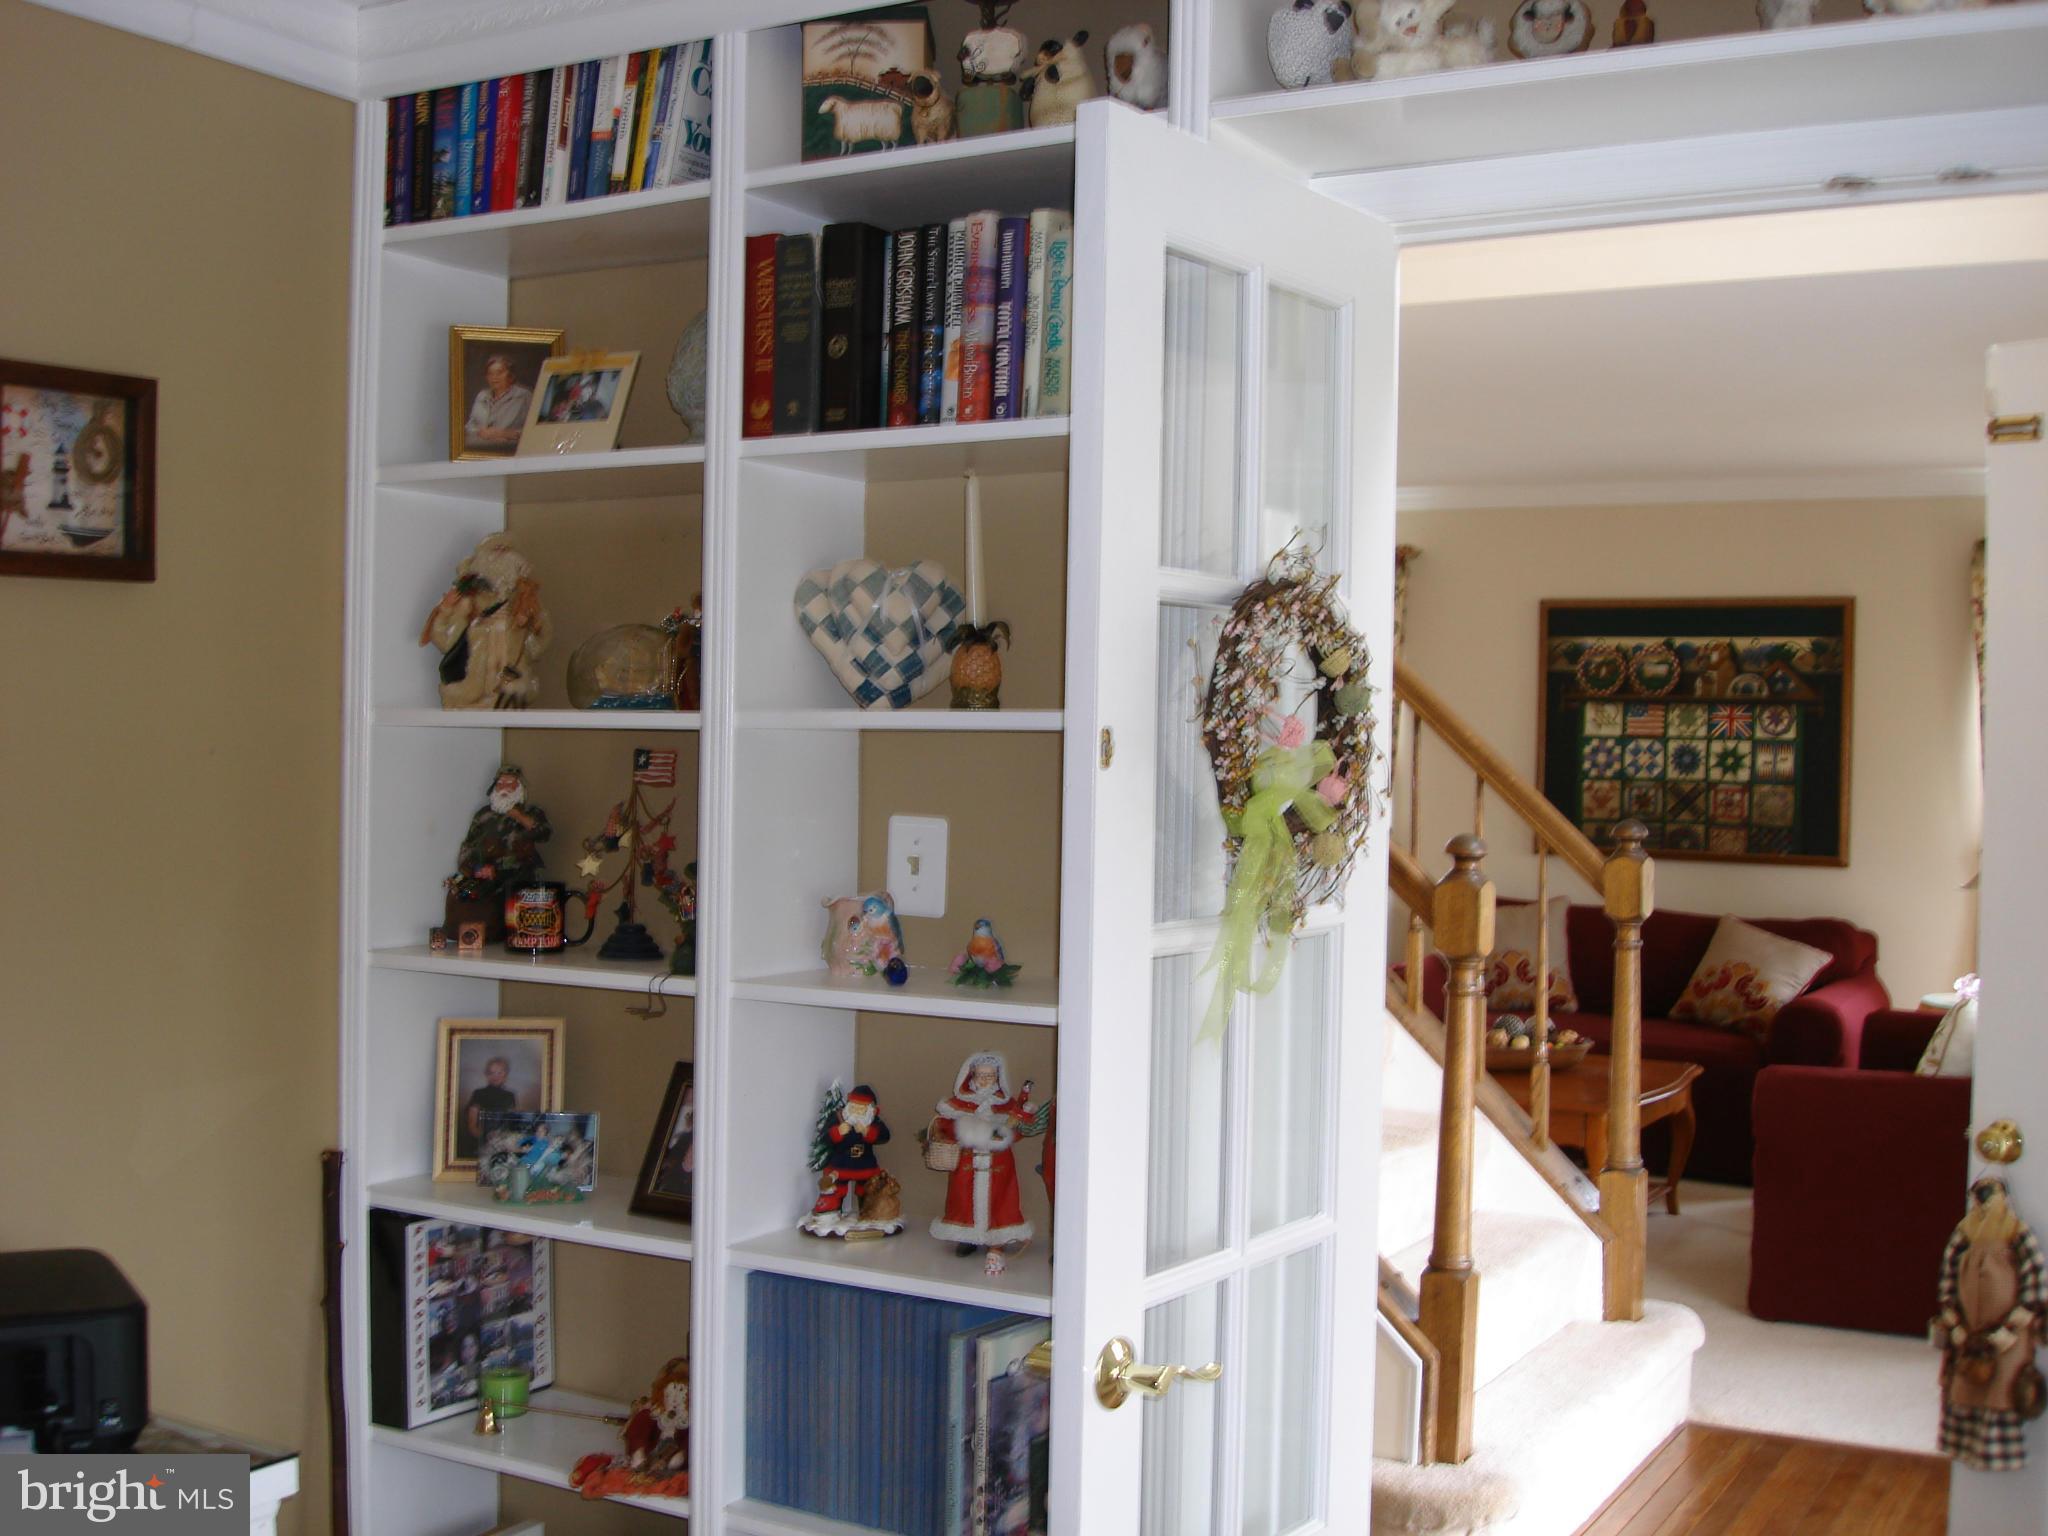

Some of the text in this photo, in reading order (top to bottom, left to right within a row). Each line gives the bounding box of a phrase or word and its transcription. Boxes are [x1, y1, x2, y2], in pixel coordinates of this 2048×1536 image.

[893, 232, 917, 326] JOHN GRISHAM
[923, 228, 941, 322] THE STREET LAWYER
[993, 301, 1013, 400] TOTAL CONTROL
